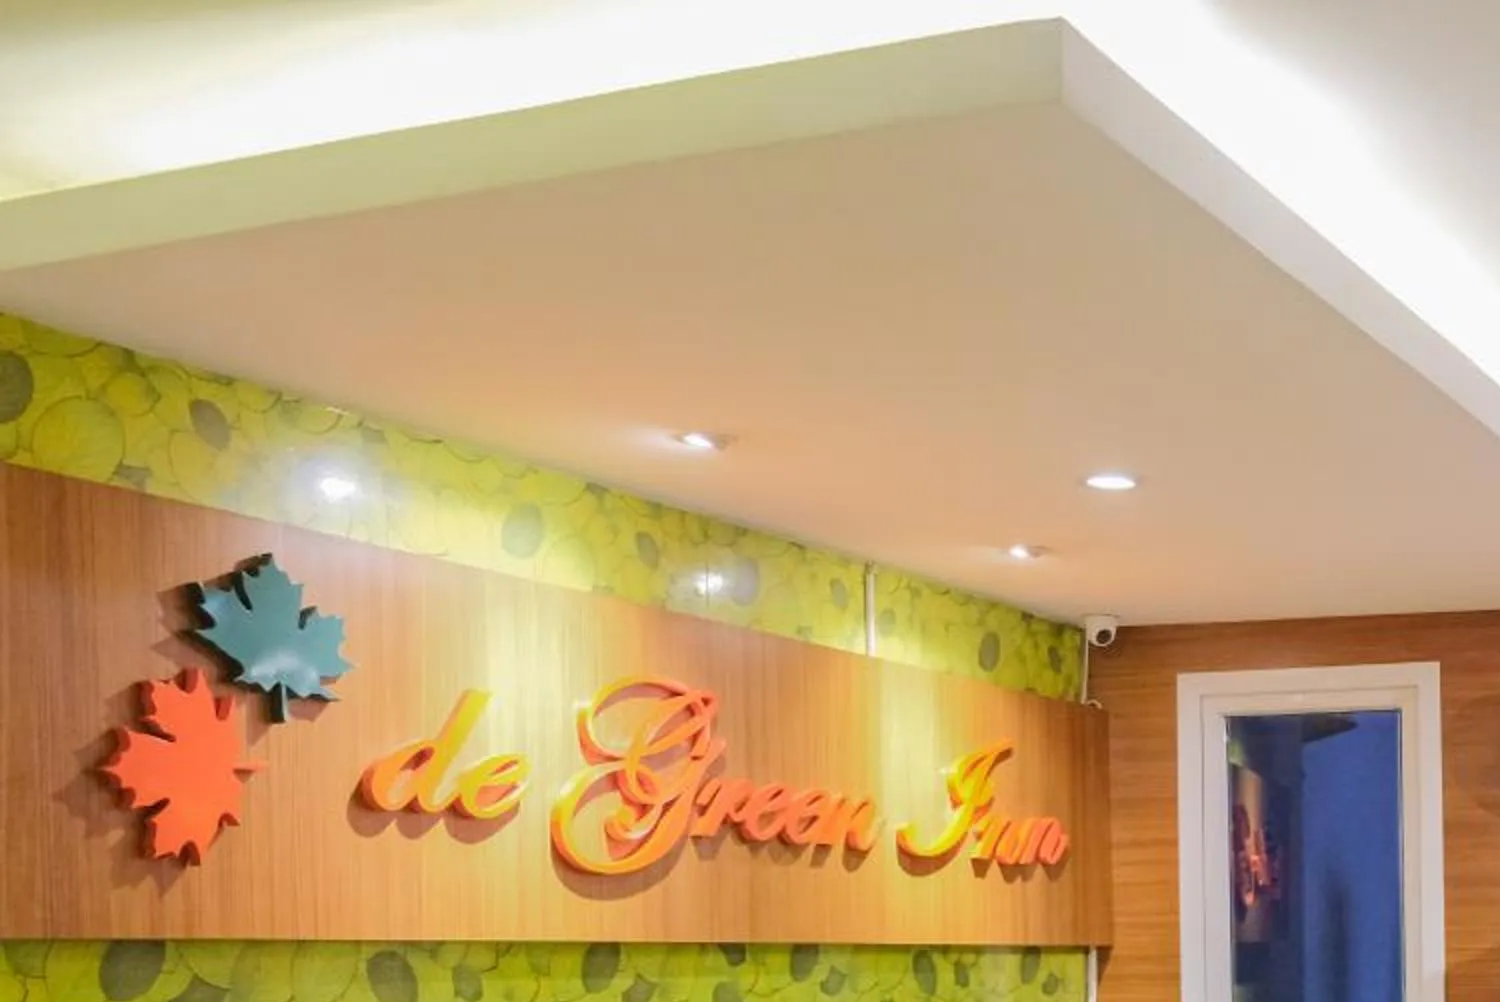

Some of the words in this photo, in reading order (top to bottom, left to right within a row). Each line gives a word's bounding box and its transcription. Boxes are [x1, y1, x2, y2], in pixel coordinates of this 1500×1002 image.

[363, 688, 528, 819] de
[550, 676, 878, 874] Green
[896, 738, 1068, 864] Inn
